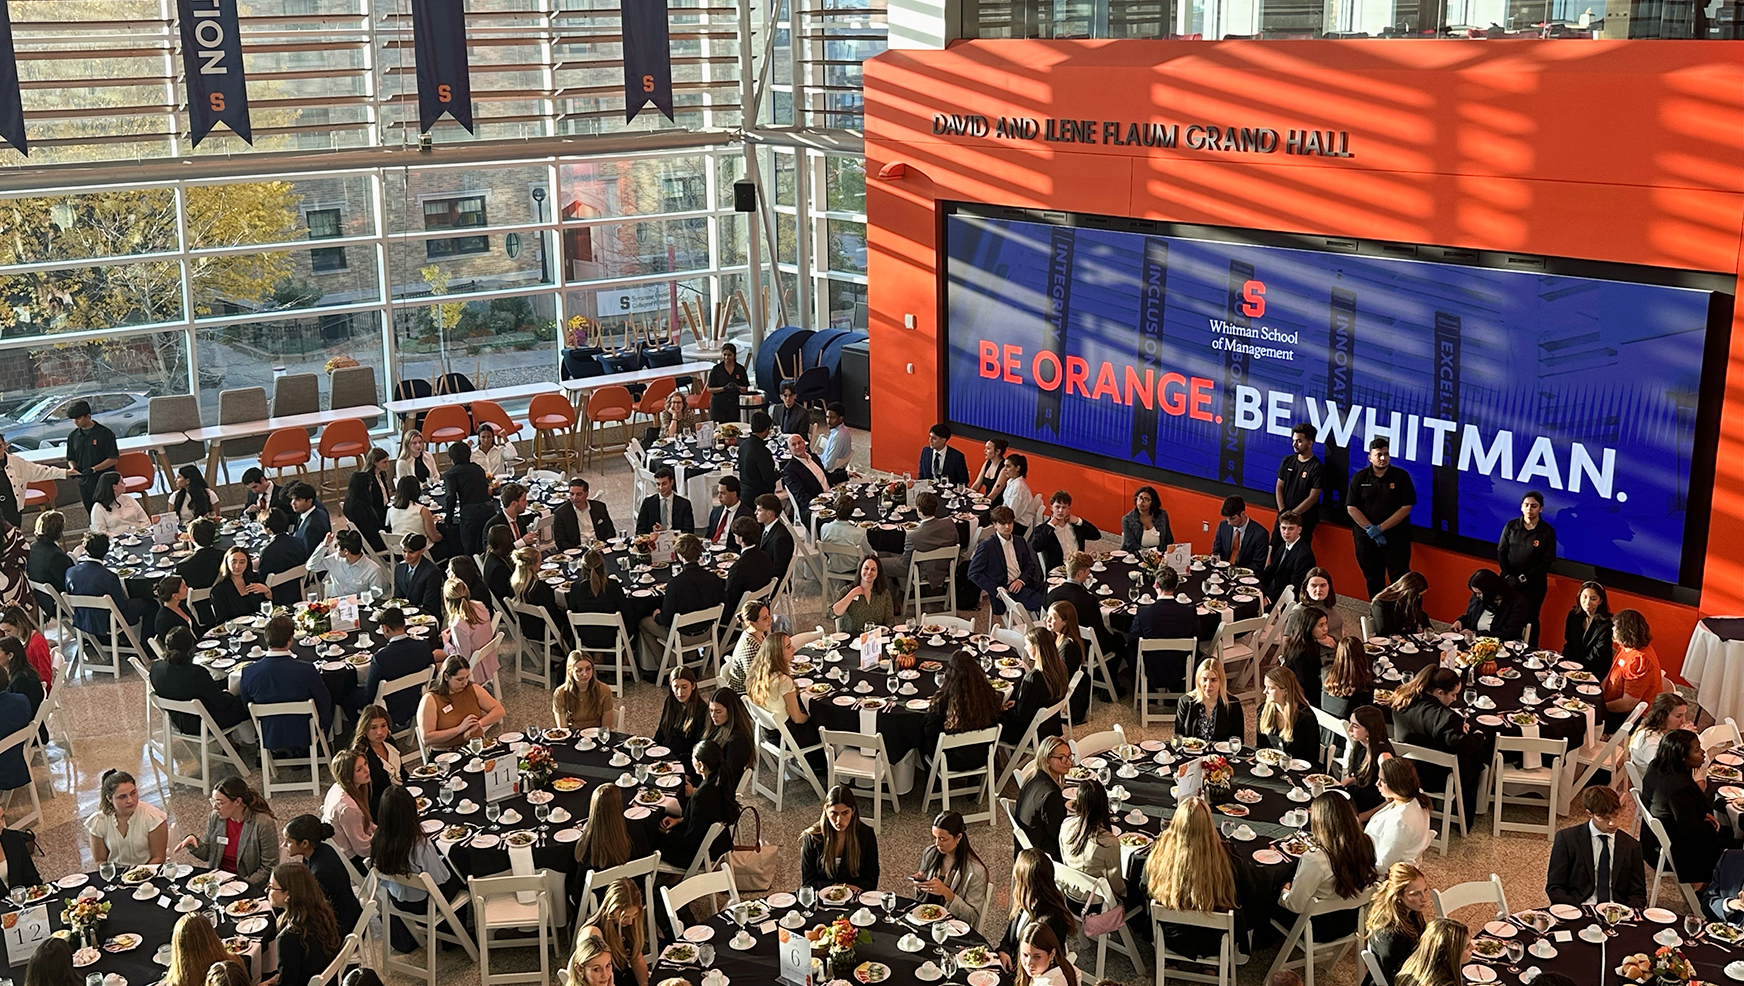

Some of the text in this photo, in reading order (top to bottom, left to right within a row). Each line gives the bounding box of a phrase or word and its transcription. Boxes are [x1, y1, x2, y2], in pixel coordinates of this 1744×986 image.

[642, 75, 654, 92] S
[210, 92, 225, 111] S
[438, 85, 451, 102] S
[933, 114, 1354, 158] DAVID AND ILENE FLAUM GRAND HALL
[1052, 243, 1068, 342] INTEGRITY
[1243, 280, 1266, 318] S
[620, 296, 630, 309] S
[1144, 264, 1161, 370] INCLUSION
[1209, 319, 1298, 344] Whitman School
[1212, 337, 1294, 361] of Management
[979, 340, 1628, 503] BE ORANGE. BE WHITMAN.
[158, 522, 173, 534] 19
[656, 540, 671, 552] 15
[1175, 553, 1183, 565] 9
[491, 768, 510, 786] 11
[1187, 772, 1195, 789] 7
[13, 923, 43, 945] 12
[791, 948, 800, 967] 6
